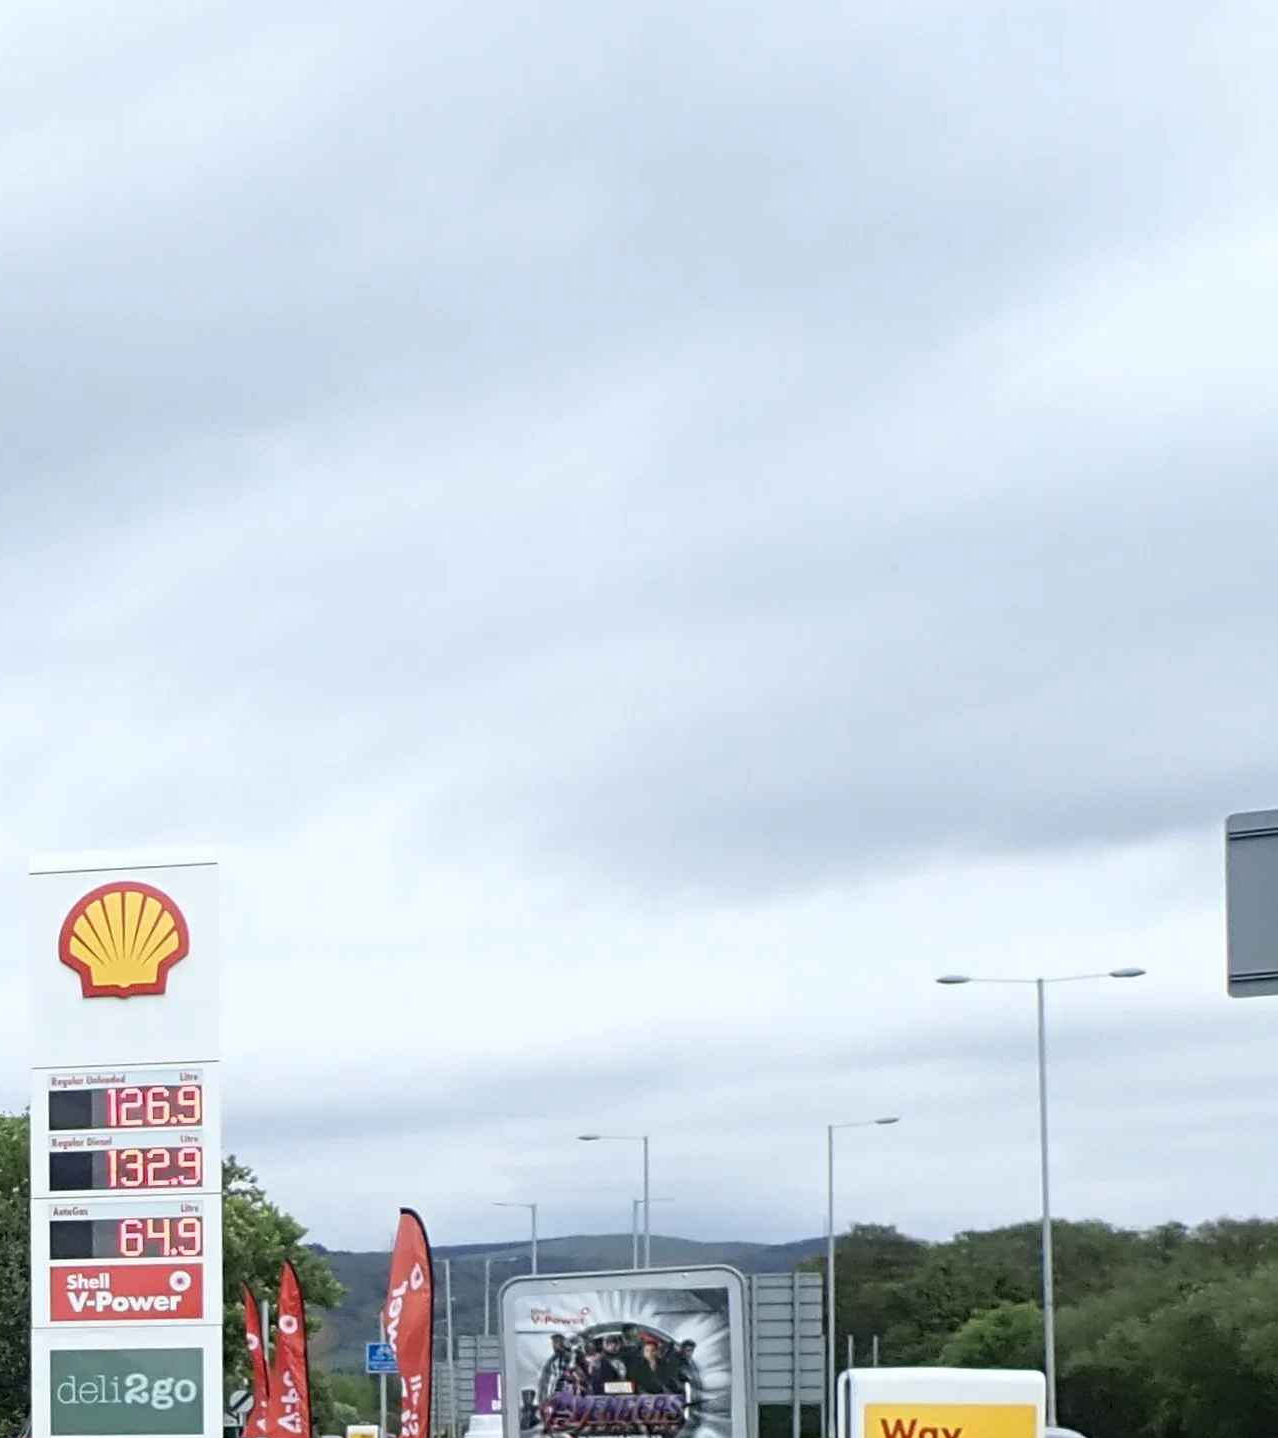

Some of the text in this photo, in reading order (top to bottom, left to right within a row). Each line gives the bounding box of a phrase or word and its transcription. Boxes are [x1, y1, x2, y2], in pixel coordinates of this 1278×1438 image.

[51, 1075, 126, 1087] Regular Unleaded
[180, 1073, 199, 1081] Litre
[107, 1086, 201, 1126] 126.9
[51, 1137, 112, 1149] Regular Diesel
[180, 1135, 199, 1143] Litre
[107, 1147, 201, 1187] 132.9
[53, 1207, 88, 1216] AutoGas
[181, 1204, 199, 1213] Litre
[120, 1218, 201, 1256] 64.9
[67, 1273, 110, 1289] Shell
[67, 1291, 181, 1312] V-Power
[57, 1373, 197, 1410] deli2go
